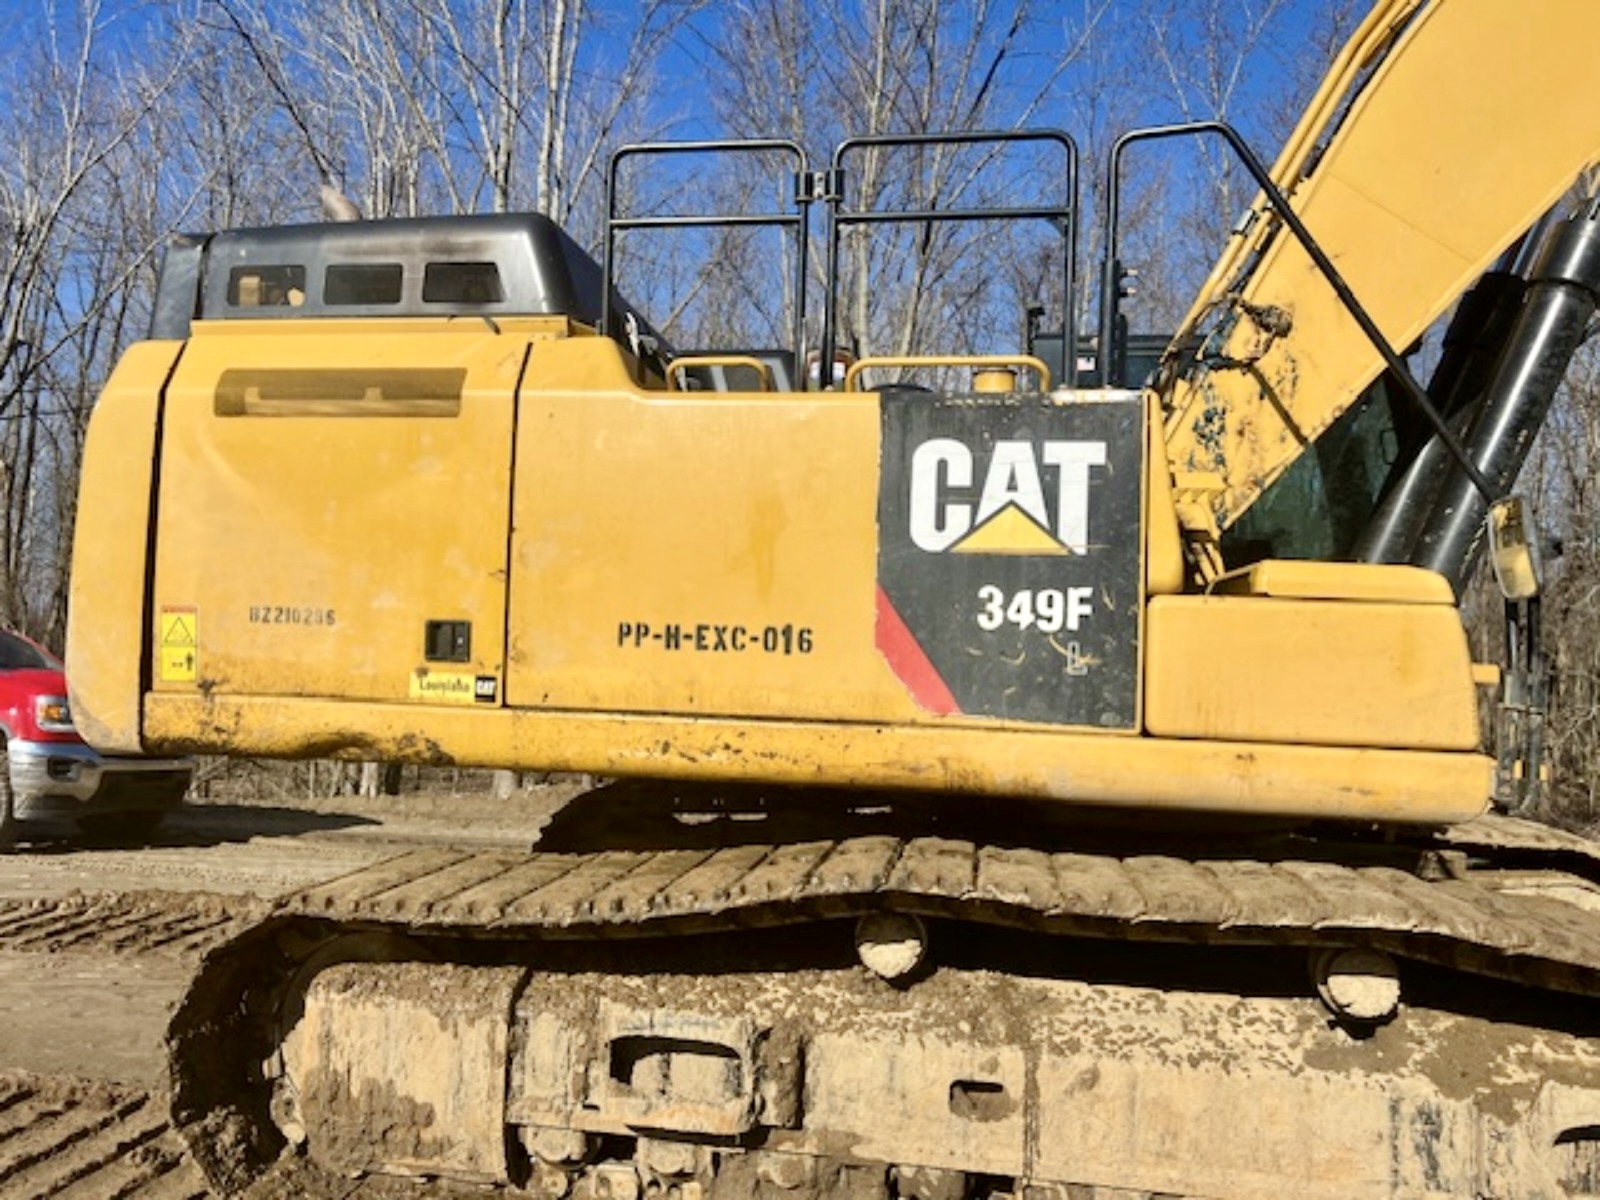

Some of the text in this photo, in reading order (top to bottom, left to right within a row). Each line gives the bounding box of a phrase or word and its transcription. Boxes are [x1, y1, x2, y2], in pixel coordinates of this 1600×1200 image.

[909, 438, 1107, 556] CAT
[976, 584, 1094, 632] 349F
[617, 622, 813, 655] PP-H-EXC-016
